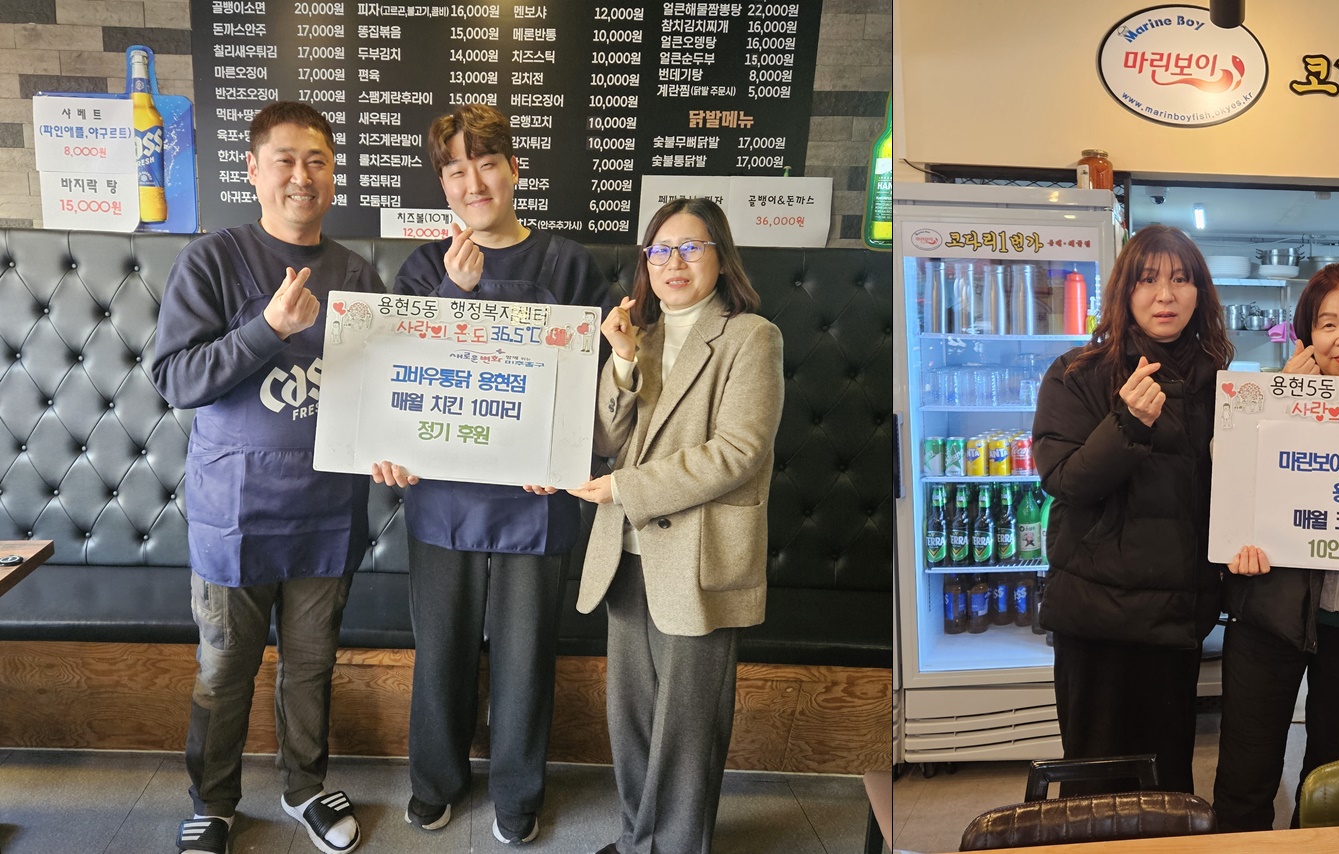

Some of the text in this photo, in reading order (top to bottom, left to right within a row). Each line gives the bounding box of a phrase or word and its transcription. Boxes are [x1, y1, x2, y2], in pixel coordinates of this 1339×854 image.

[212, 0, 345, 17] 골뱅이소면 20,000원
[450, 5, 500, 20] 16,000원
[513, 5, 644, 22] 멘보샤 12,000원
[663, 2, 799, 18] 얼큰해물짬뽕탕 22,000원
[212, 22, 345, 39] 돈까스안주 17,000원
[358, 25, 499, 42] 똥집볶음 15,000원
[512, 27, 643, 44] 메론반통 10,000원
[661, 19, 798, 35] 참치김치찌개 16,000원
[1123, 15, 1206, 43] Marine Boy
[213, 44, 345, 61] 칠리새우튀김 17,000원
[746, 37, 796, 51] 16,000원
[358, 47, 499, 64] 두부김치 14,000원
[511, 49, 642, 66] 치즈스틱 10,000원
[659, 51, 795, 68] 얼큰순두부 15,000원
[214, 66, 346, 82] 마른오징어 17,000원
[358, 68, 498, 86] 편육 13,000원
[658, 67, 793, 84] 번데기탕 8,000원
[1123, 51, 1219, 86] 마린보이
[511, 71, 640, 88] 김치전 10,000원
[215, 87, 346, 104] 반건조오징어 17,000원
[358, 91, 498, 106] 스팸계란후라이 15,000원
[747, 85, 791, 100] 5,000원
[510, 93, 639, 110] 버터오징어 10,000원
[359, 112, 401, 126] 새우튀김
[509, 115, 637, 131] 은행꼬치 10,000원
[688, 110, 755, 129] 닭발메뉴
[359, 132, 422, 147] 치즈계란말이
[588, 137, 636, 152] 10,000원
[652, 135, 786, 151] 숯불무뼈닭발 17,000원
[63, 146, 107, 159] 8,000원
[217, 149, 248, 163] 한치+
[592, 158, 634, 172] 7,000원
[651, 154, 784, 169] 숯불통닭발 17,000원
[219, 170, 250, 183] 쥐포구
[359, 174, 401, 188] 똥집튀김
[60, 177, 118, 194] 바지락 탕
[514, 178, 632, 193] 른안주 7,000원
[220, 190, 257, 204] 아귀포+
[513, 198, 631, 213] 포튀김 6,000원
[59, 199, 122, 216] 15,000원
[588, 219, 630, 233] 6,000원
[755, 216, 806, 228] 36,000원
[402, 227, 449, 239] 12,000원
[945, 230, 1045, 253] 코다리1번가
[377, 295, 439, 319] 용현5동
[396, 320, 448, 340] 사랑의
[453, 323, 488, 344] 온도
[390, 364, 527, 394] 고바우통닭 용현점
[1269, 375, 1336, 399] 용현5동
[391, 390, 523, 421] 매월 치킨 10마리
[417, 420, 491, 445] 정기 후원
[1293, 509, 1328, 530] 매월
